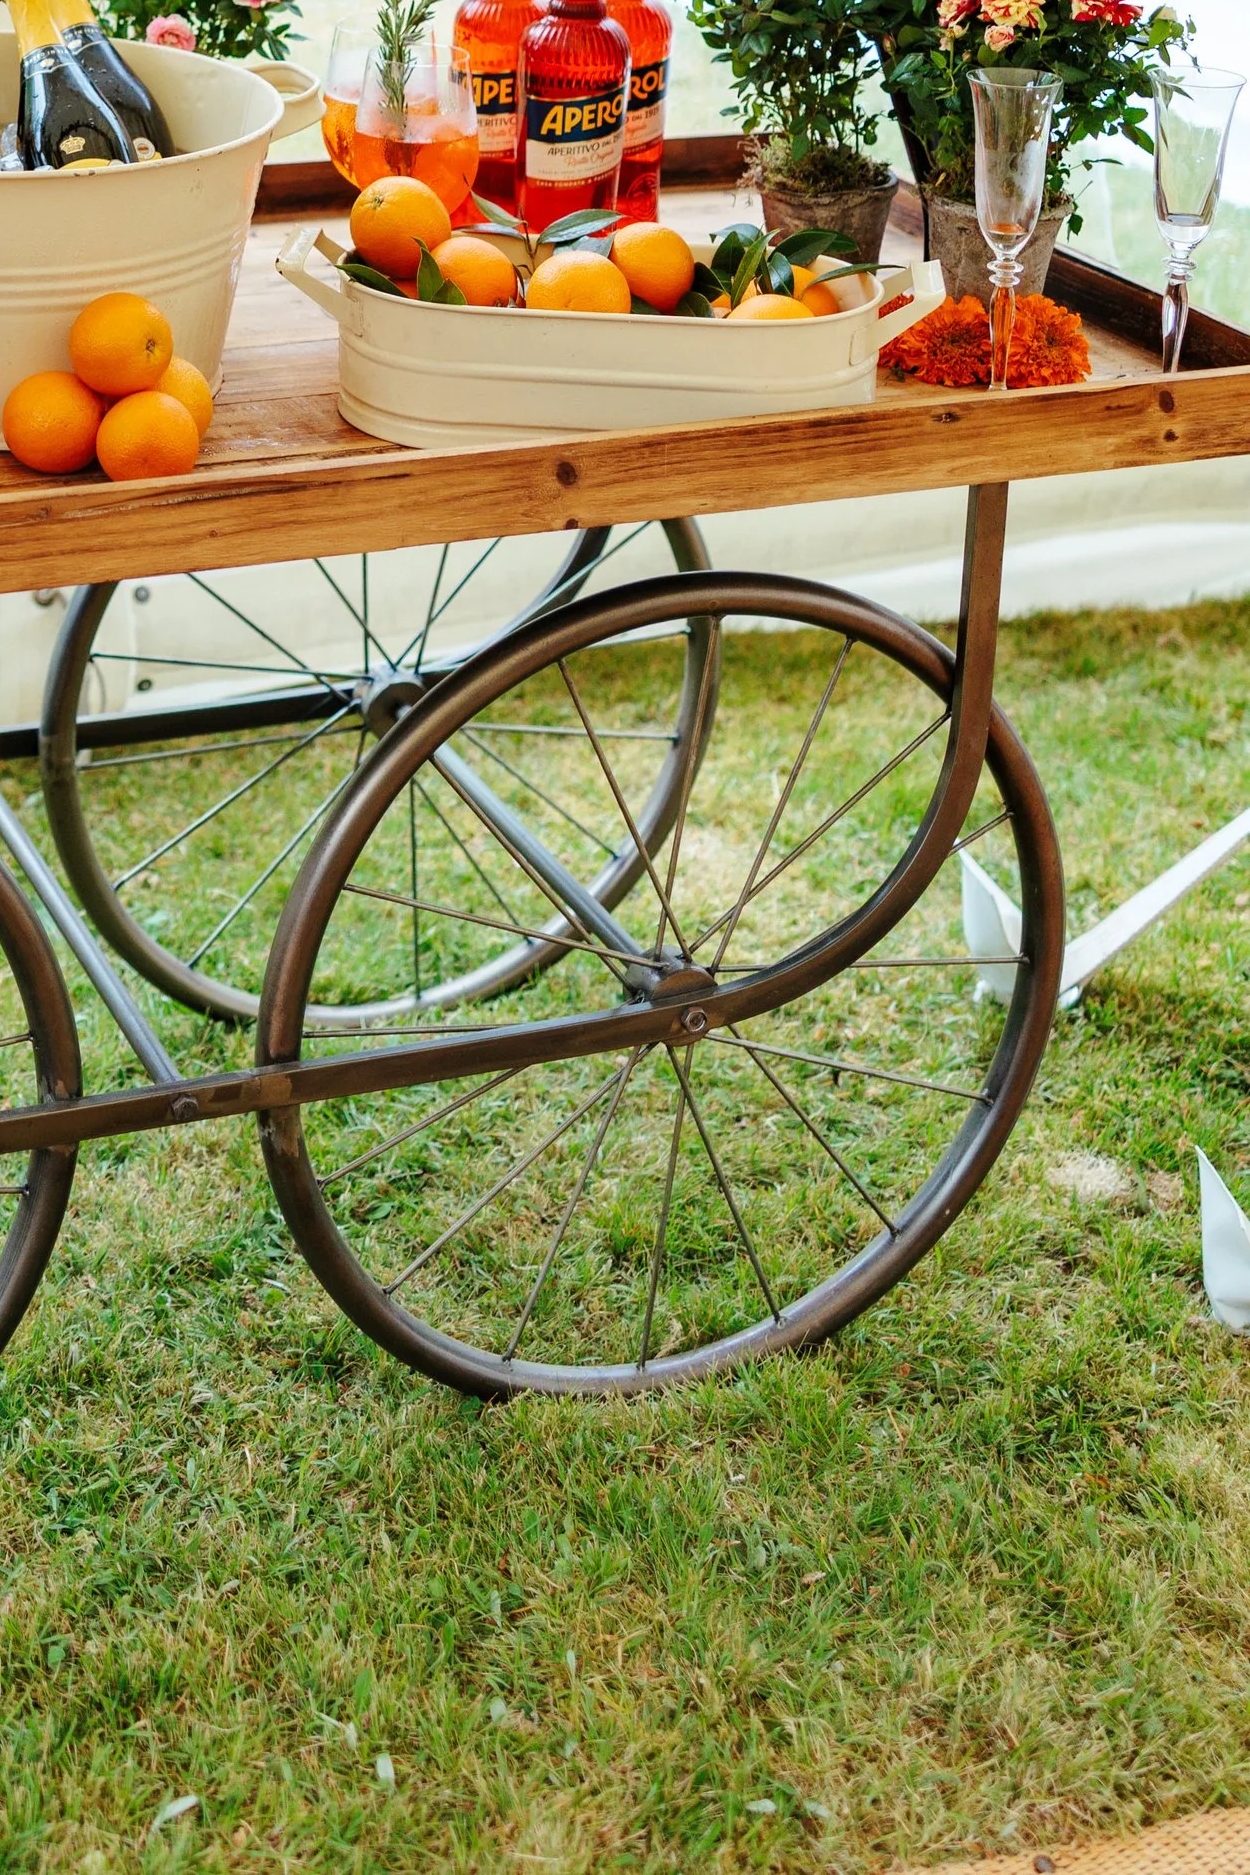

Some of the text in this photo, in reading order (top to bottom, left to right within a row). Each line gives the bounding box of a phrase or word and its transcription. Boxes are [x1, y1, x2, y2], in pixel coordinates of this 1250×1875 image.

[462, 76, 514, 108] APE
[628, 66, 665, 101] ROL
[540, 94, 623, 136] APERO
[547, 142, 600, 157] APERITIVO
